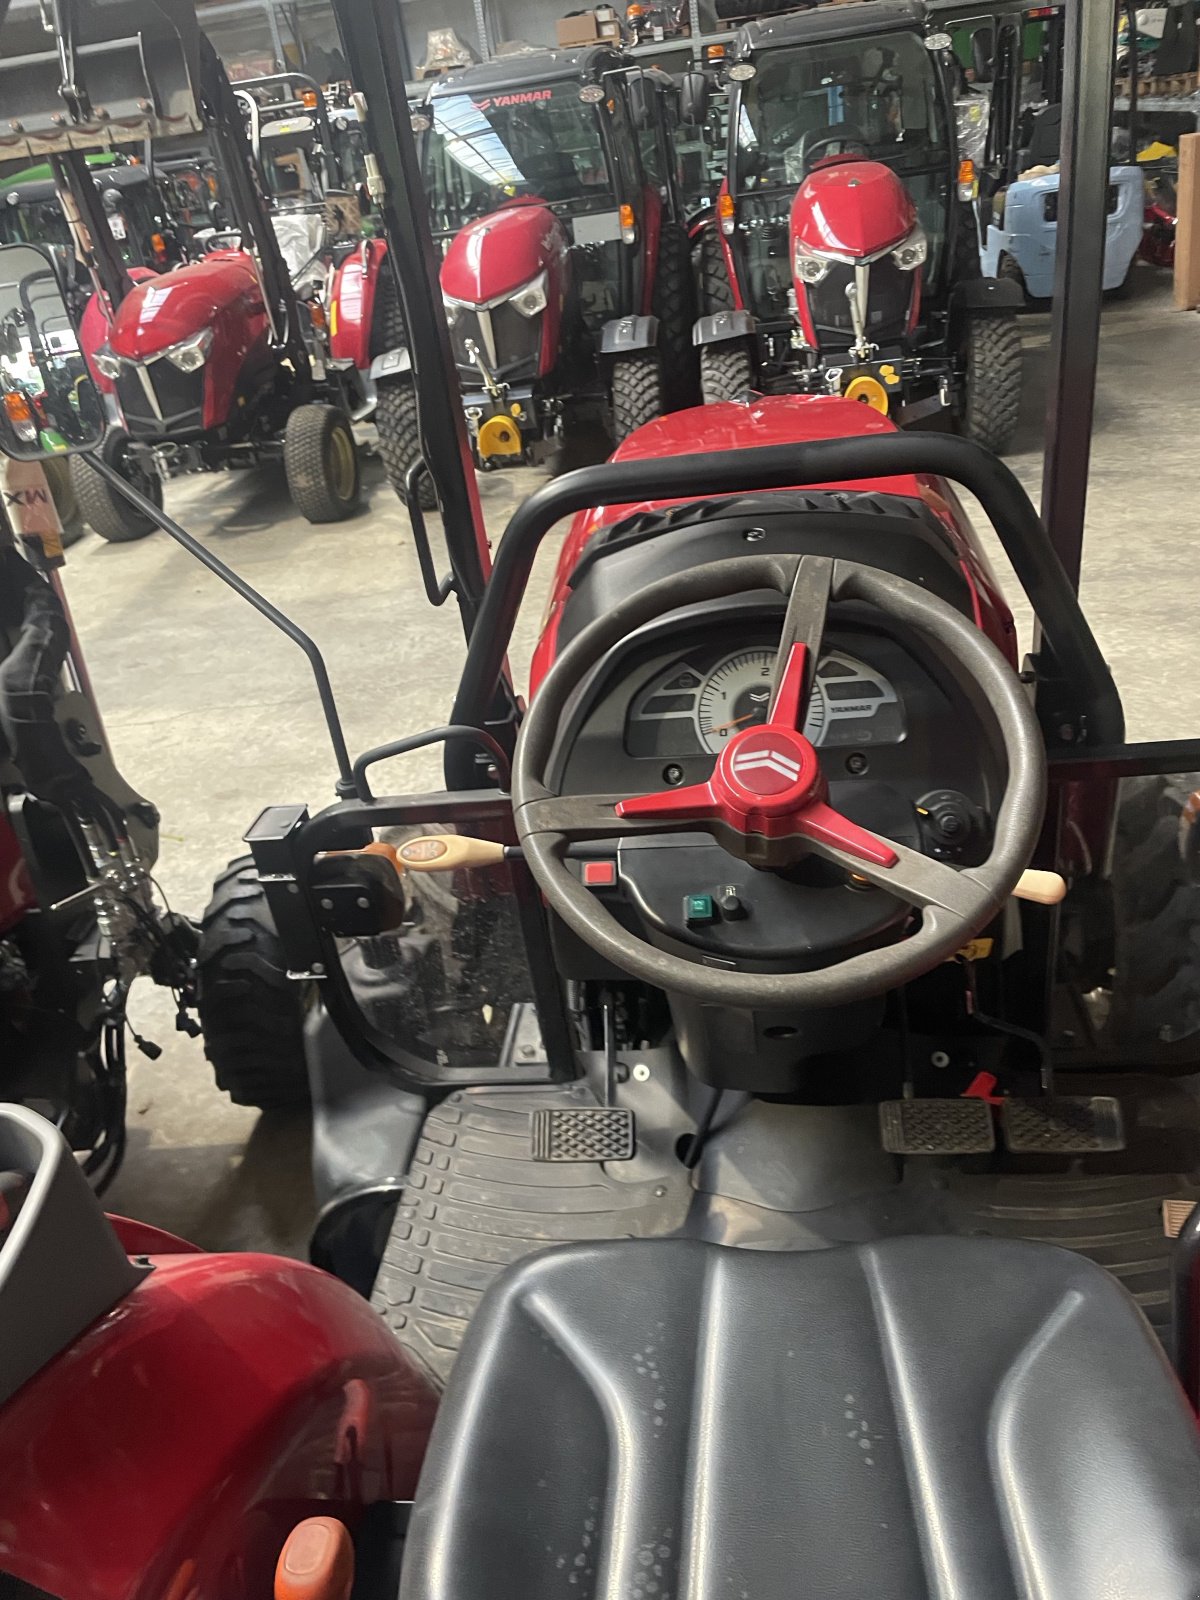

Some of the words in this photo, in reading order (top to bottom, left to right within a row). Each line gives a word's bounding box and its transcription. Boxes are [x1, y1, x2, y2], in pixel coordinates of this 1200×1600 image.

[493, 90, 552, 107] YANMAR
[761, 668, 769, 676] 2
[720, 729, 727, 737] 0
